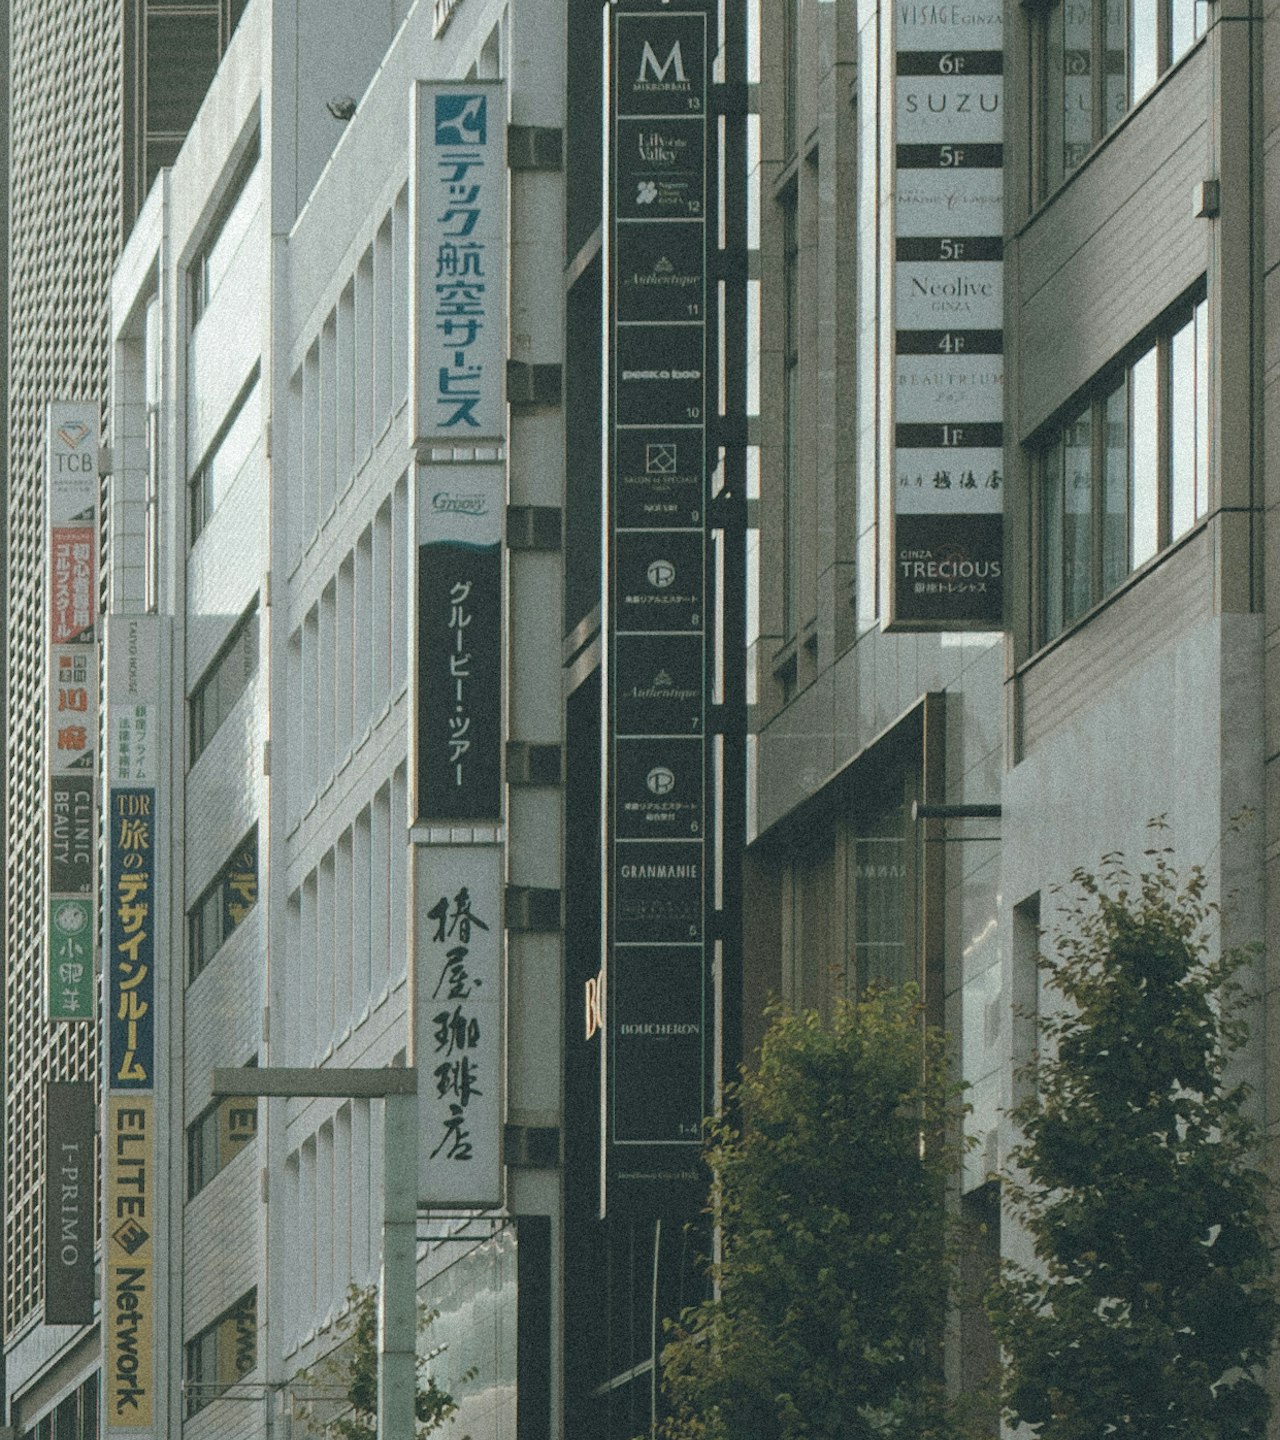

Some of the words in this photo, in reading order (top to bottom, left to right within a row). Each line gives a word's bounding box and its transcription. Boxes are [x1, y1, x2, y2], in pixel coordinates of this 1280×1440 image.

[902, 5, 961, 25] VISAGE
[962, 15, 1002, 24] GINZA
[939, 53, 964, 73] 6F
[688, 97, 700, 109] 13
[906, 94, 998, 112] SUZU
[940, 146, 964, 166] 5F
[688, 200, 700, 212] 12
[940, 239, 965, 259] 5F
[435, 153, 485, 428] テック航空サービス
[911, 276, 992, 298] Neolive
[688, 304, 699, 315] 11
[931, 302, 971, 311] GINZA
[939, 333, 965, 353] 4F
[687, 407, 700, 418] 10
[941, 425, 964, 446] 1F
[55, 453, 93, 472] TCB
[433, 492, 486, 512] Groovy
[900, 550, 932, 559] GINZA
[901, 561, 1002, 578] TRECIOUS
[56, 544, 71, 637] ゴルフスクール
[73, 543, 90, 626] 初心者専用
[449, 581, 472, 786] グルービー・ツアー
[692, 717, 699, 729] 7
[54, 791, 69, 864] BEAUTY
[74, 791, 90, 864] CLINIC
[691, 821, 698, 832] 6
[621, 864, 697, 879] GRANMANIE
[427, 886, 489, 1161] 椿屋珈琲店
[621, 1024, 700, 1035] BOUCHERON
[679, 1123, 698, 1134] 1-4
[116, 1108, 145, 1217] ELITE
[61, 1143, 79, 1266] I-PRIMO
